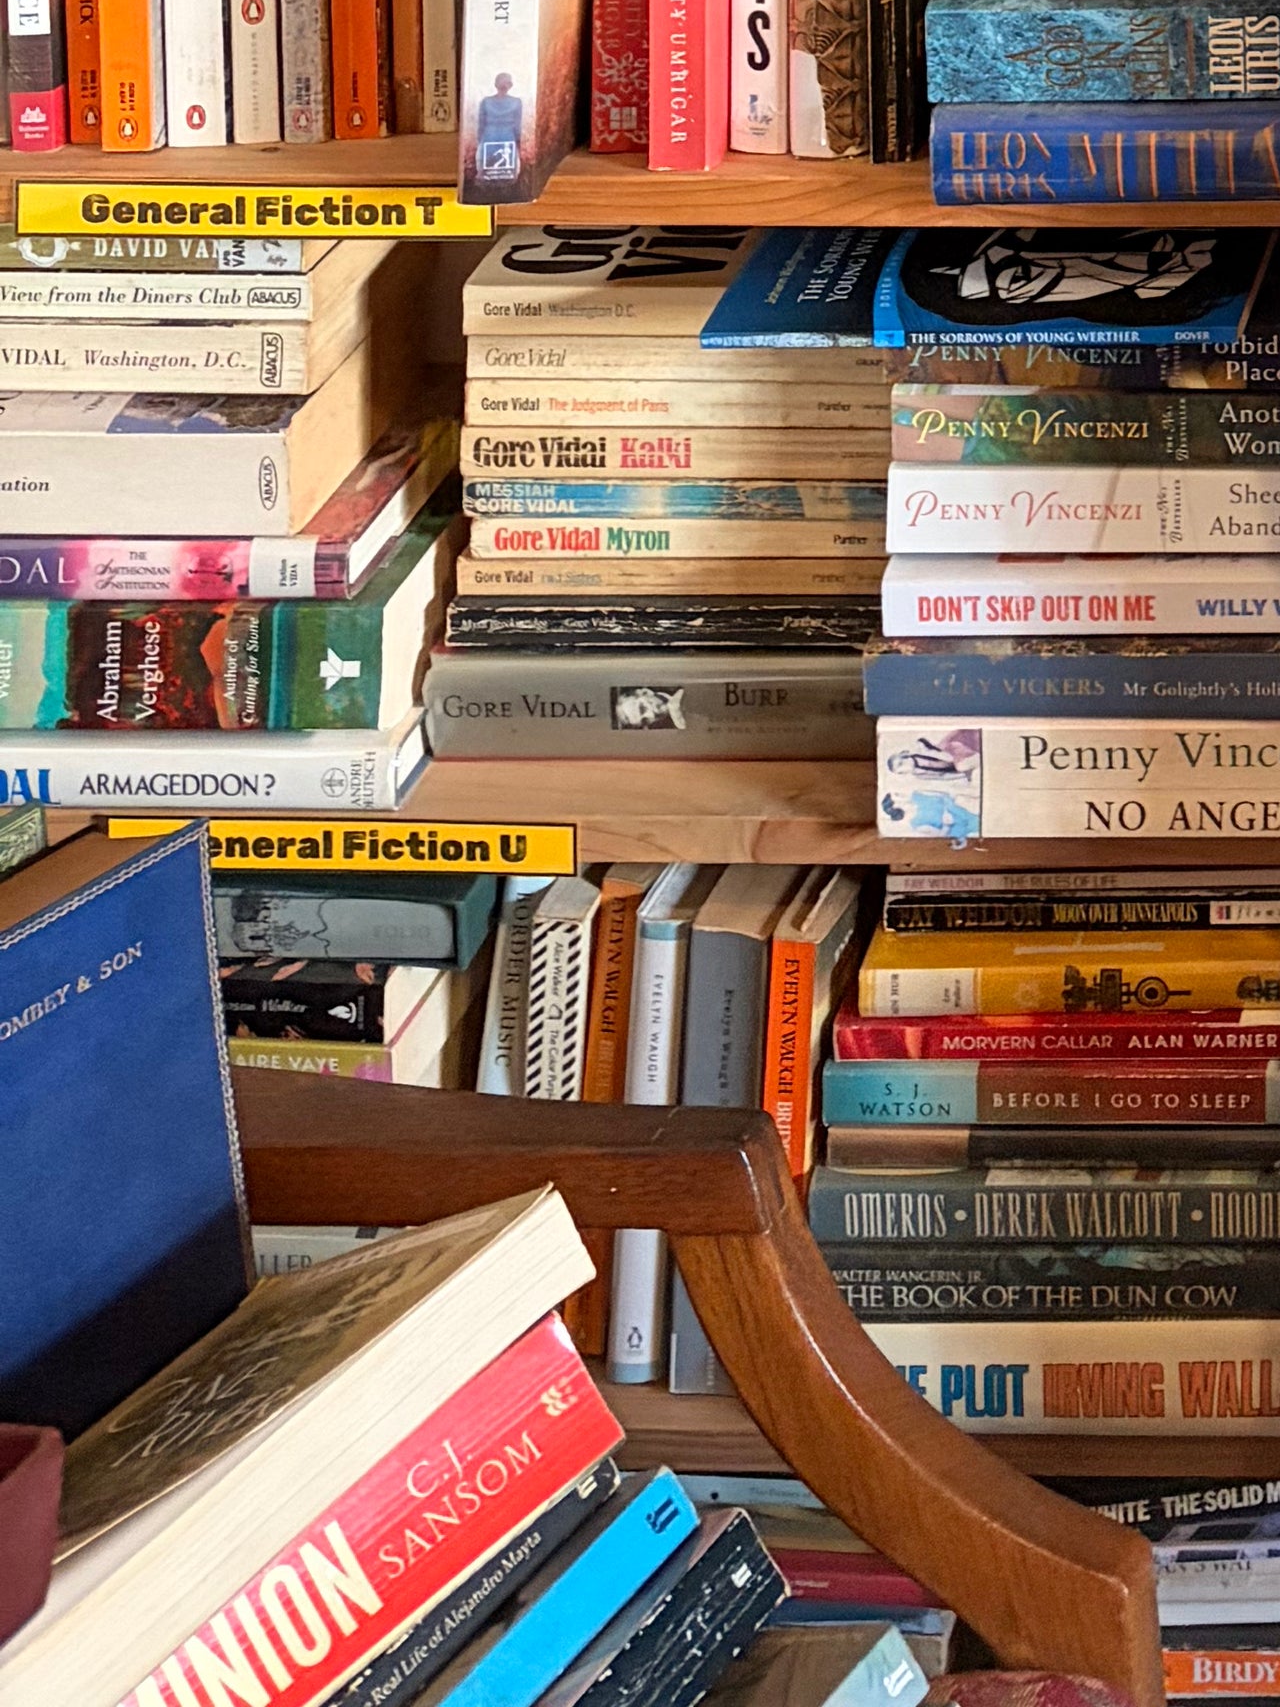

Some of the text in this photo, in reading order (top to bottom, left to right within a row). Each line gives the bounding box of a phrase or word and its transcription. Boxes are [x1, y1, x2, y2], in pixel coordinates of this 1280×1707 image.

[82, 195, 442, 225] General Fiction T
[473, 437, 693, 469] Gore Vidal Kalki
[80, 774, 275, 798] ARMAGEDDON?
[1085, 800, 1146, 832] NO
[209, 832, 527, 862] eneral Fiction U
[942, 1364, 1029, 1418] PLOT
[1042, 1364, 1165, 1418] IRVING
[406, 1439, 474, 1498] C.J.
[378, 1430, 543, 1580] SANSOM
[1192, 1657, 1279, 1684] BIRDY
